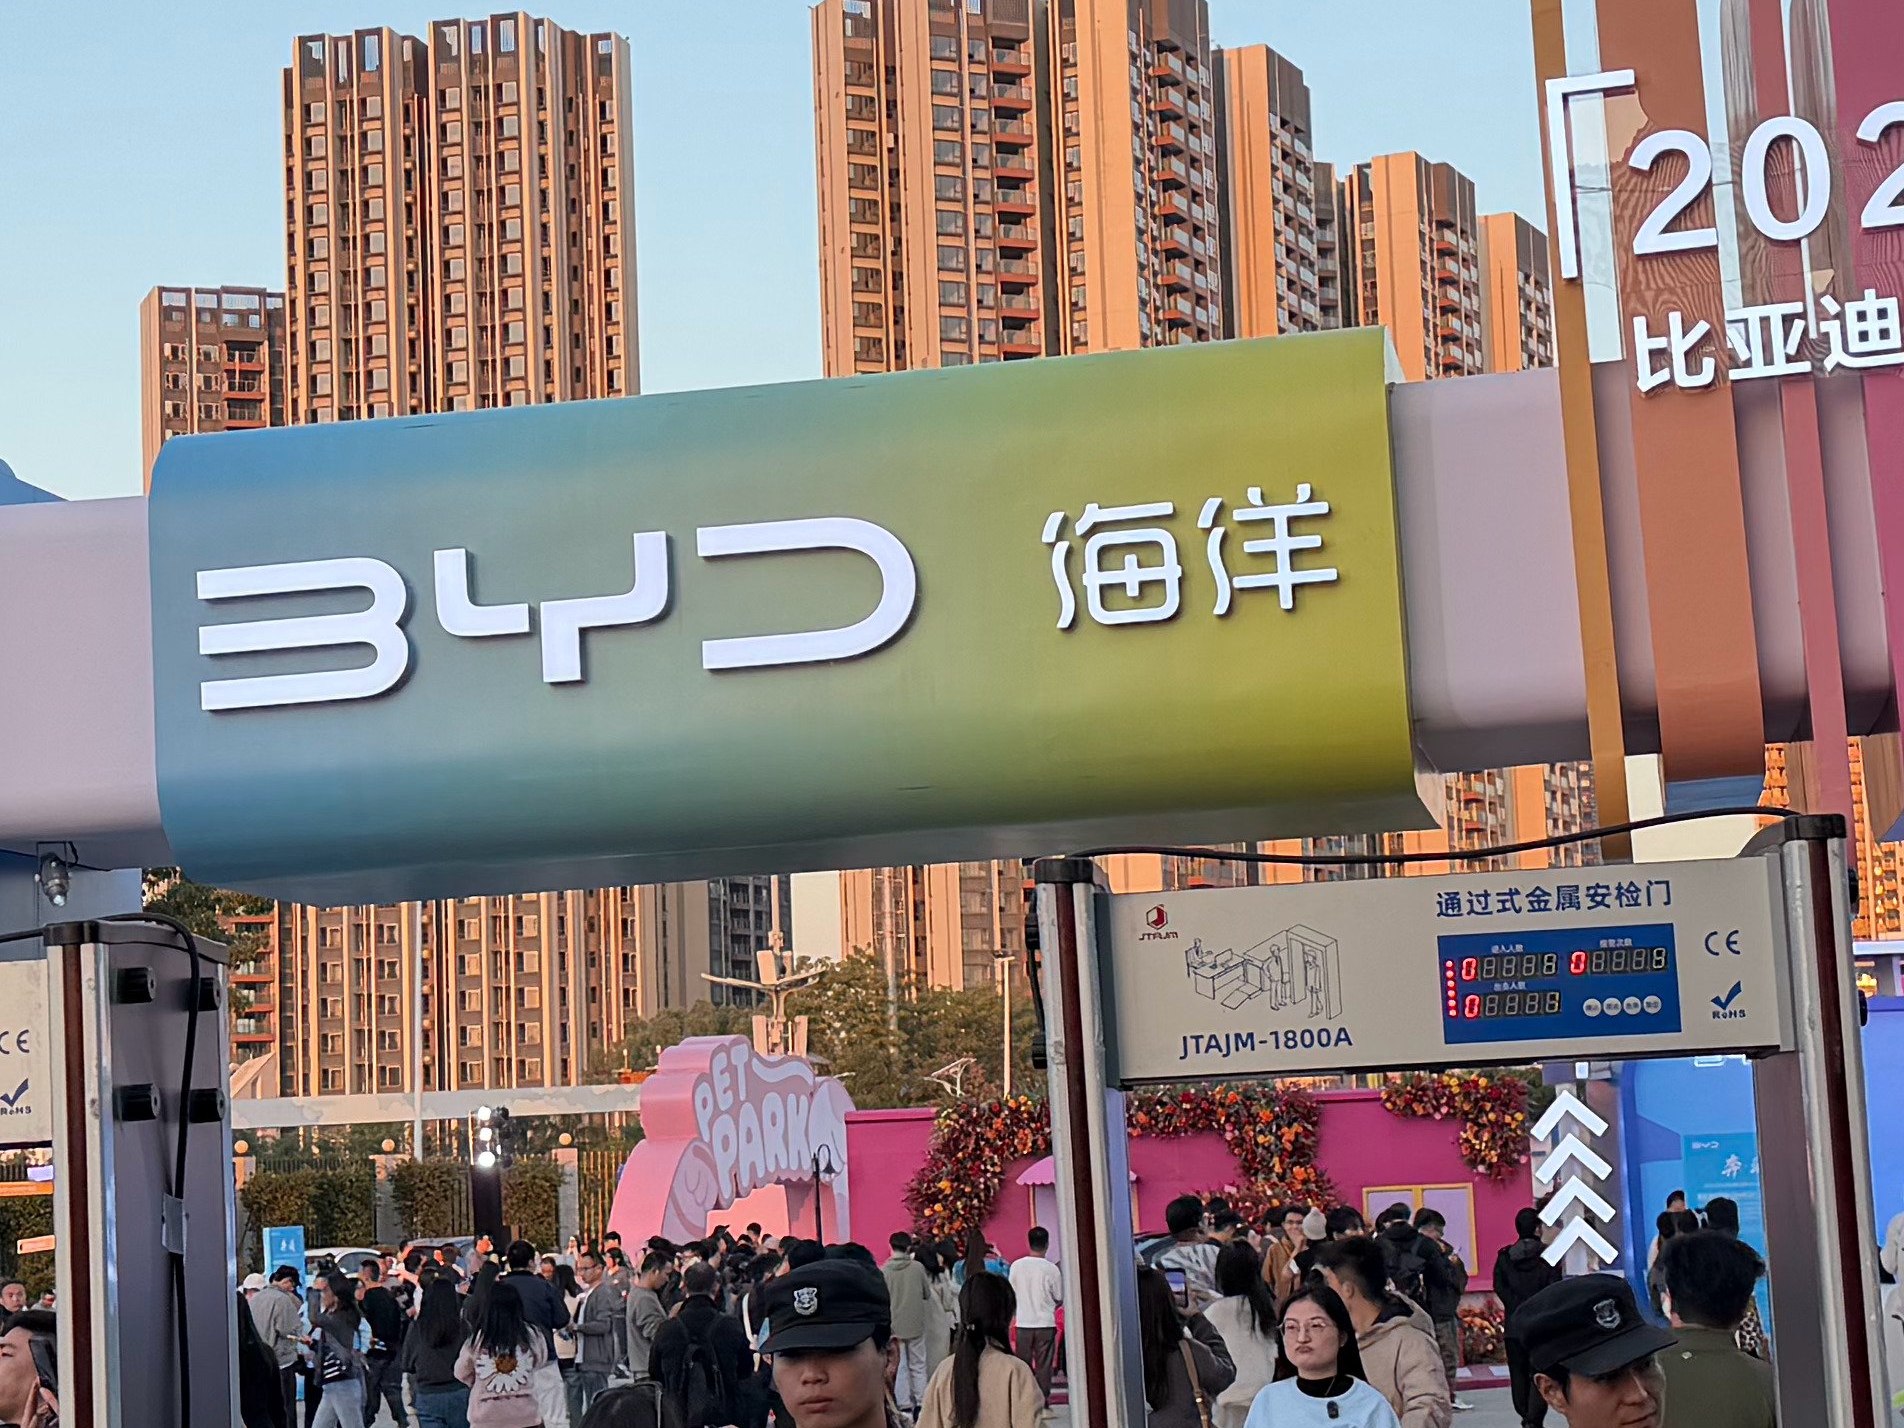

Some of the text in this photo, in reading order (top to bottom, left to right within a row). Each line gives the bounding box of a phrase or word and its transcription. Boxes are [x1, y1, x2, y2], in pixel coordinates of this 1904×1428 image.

[197, 483, 1342, 713] BYD 海洋
[1435, 879, 1672, 918] 通过式金属安检门
[694, 1043, 749, 1144] PET
[1179, 1026, 1354, 1061] JTAJM-1800A
[712, 1091, 813, 1200] PARK
